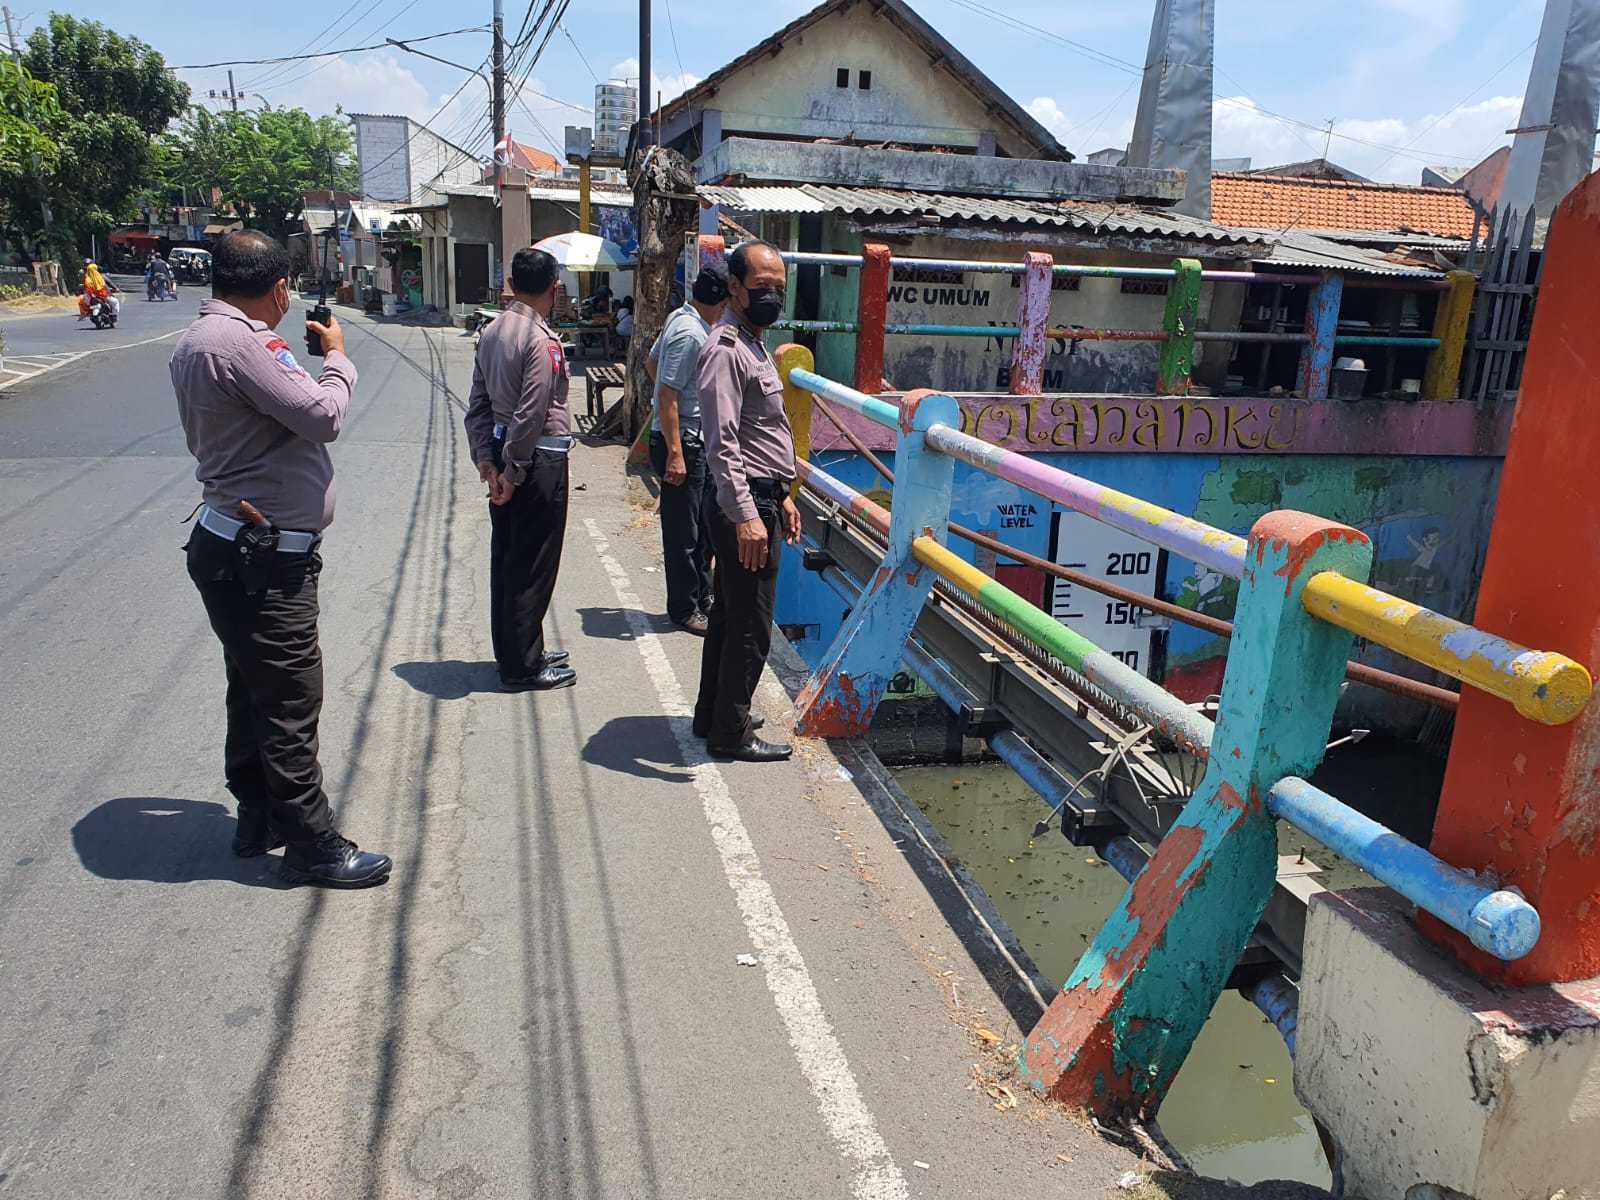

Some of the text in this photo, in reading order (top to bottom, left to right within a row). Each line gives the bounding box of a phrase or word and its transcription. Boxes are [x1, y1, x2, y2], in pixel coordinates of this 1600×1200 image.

[886, 286, 990, 307] WC UMUM
[996, 366, 1064, 389] BM
[997, 504, 1038, 516] WATER
[1000, 517, 1035, 528] LEVEL
[1106, 552, 1151, 576] 200
